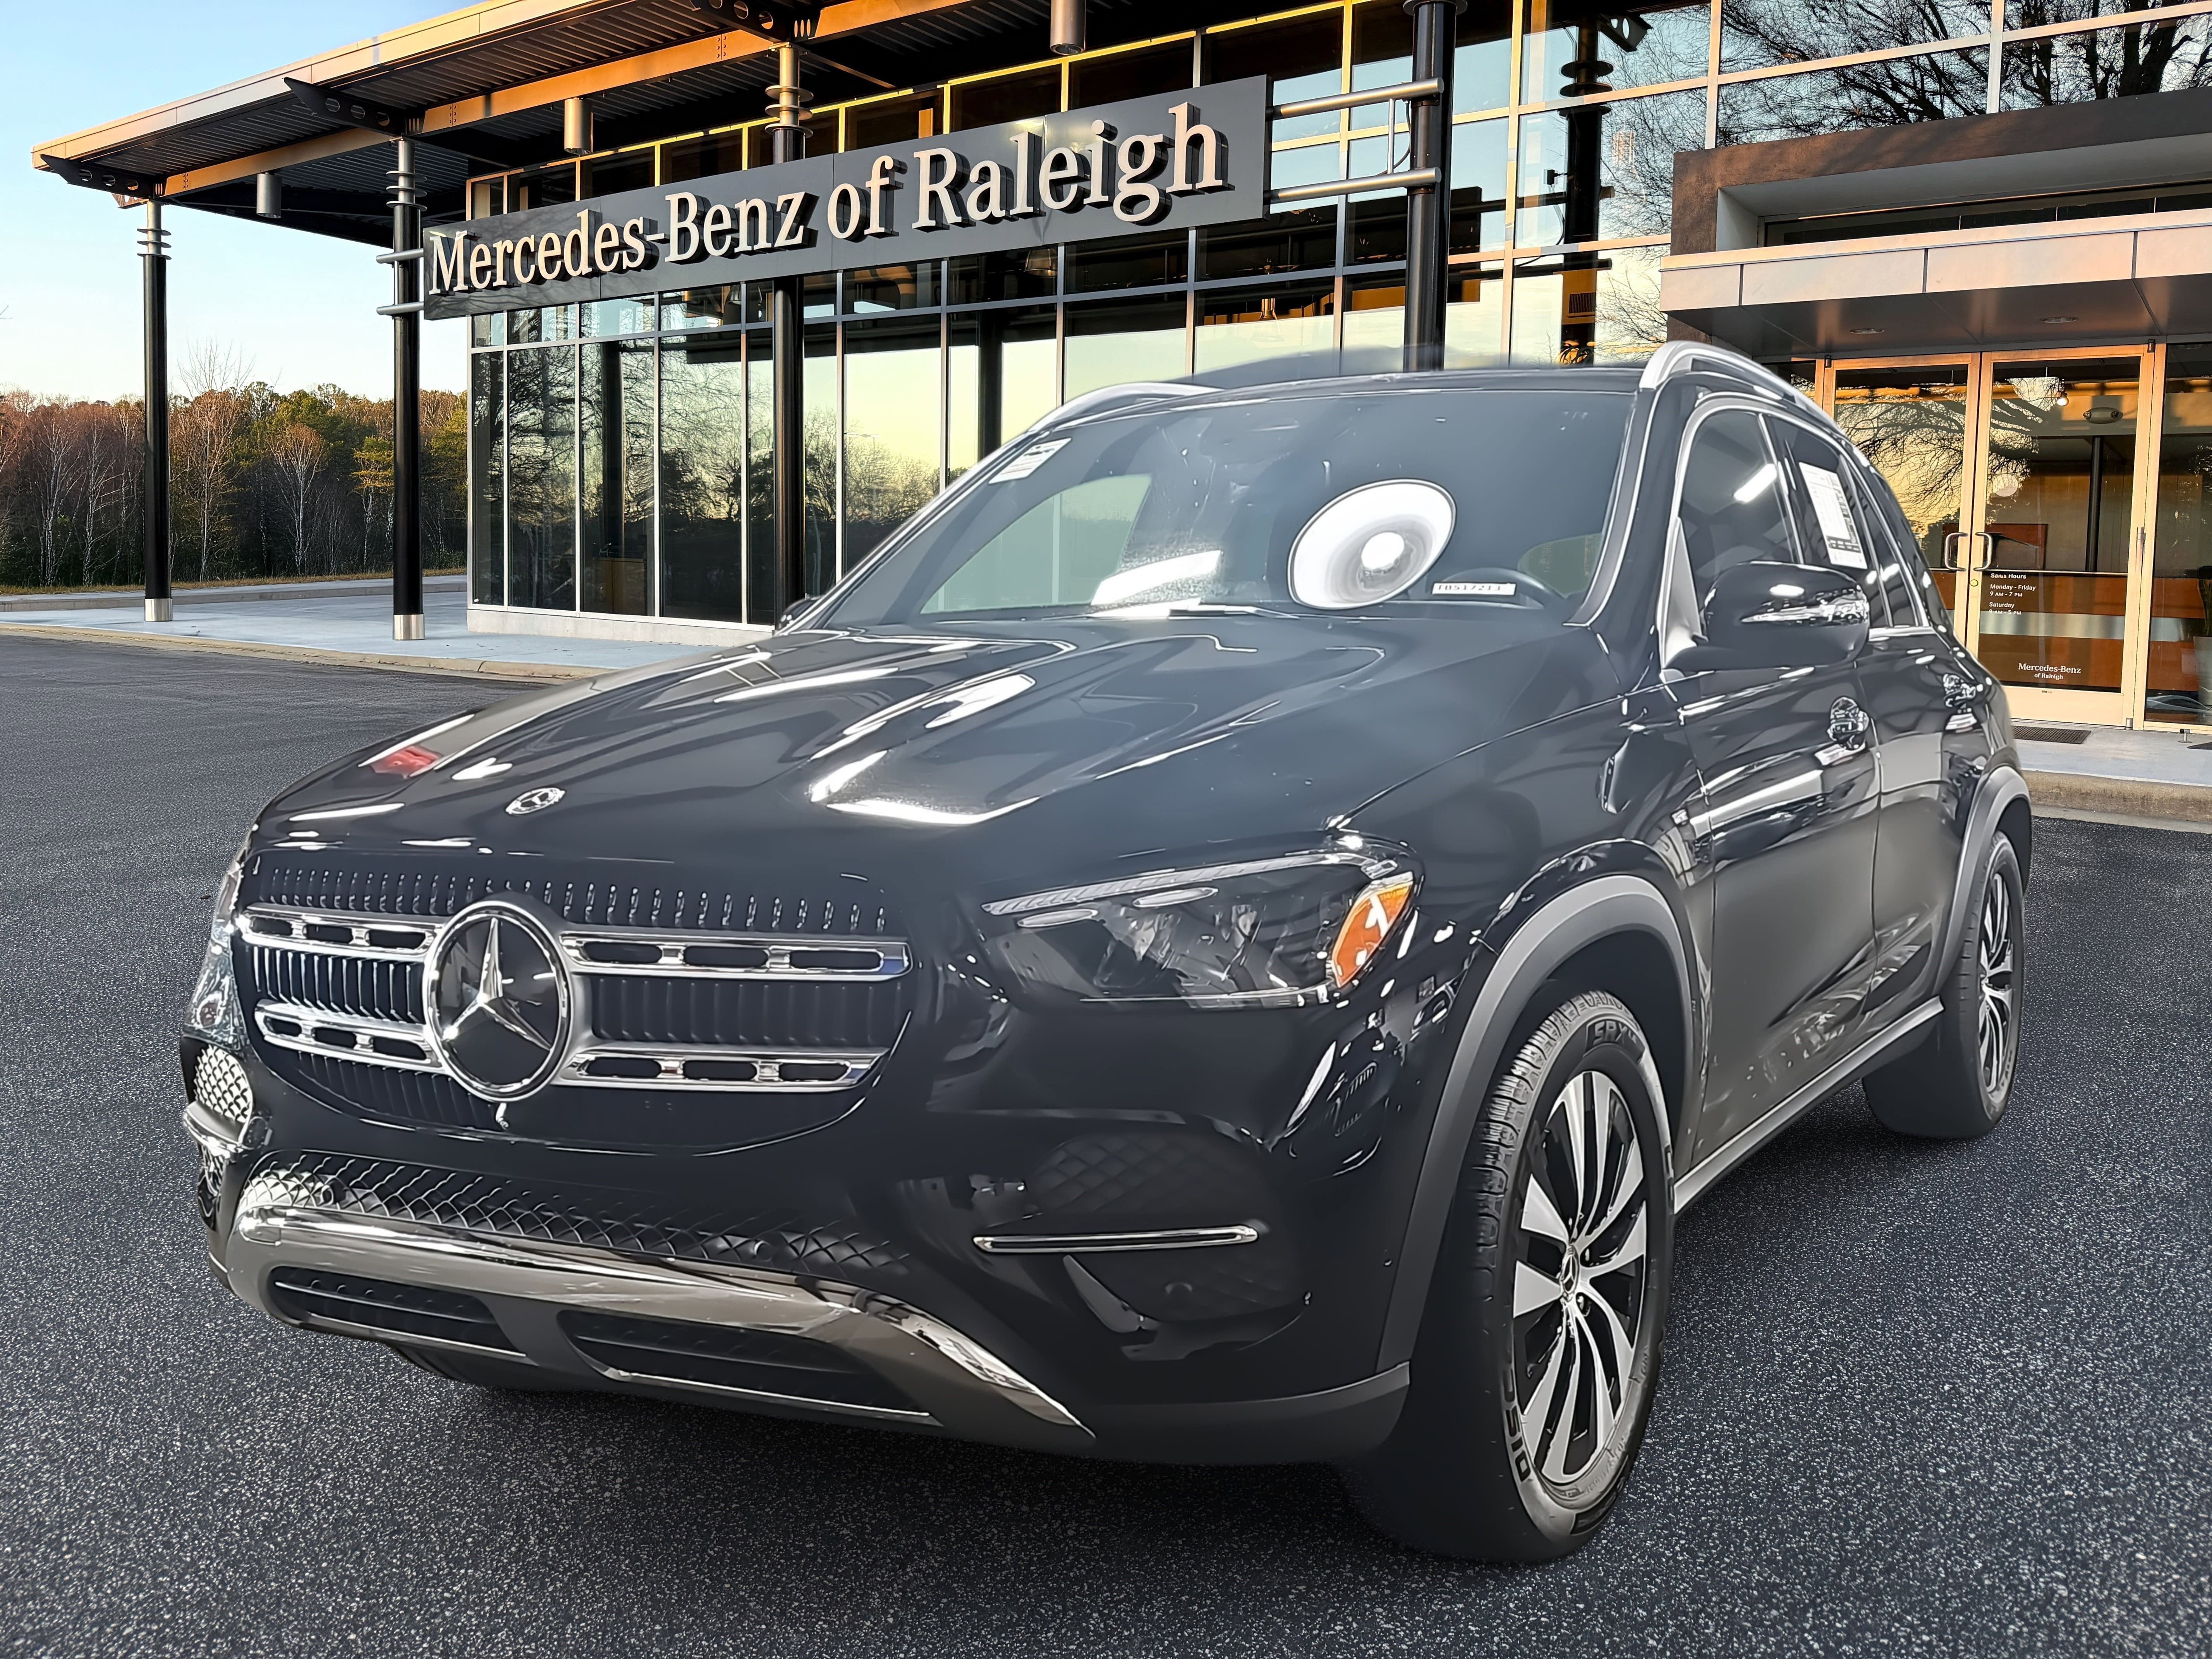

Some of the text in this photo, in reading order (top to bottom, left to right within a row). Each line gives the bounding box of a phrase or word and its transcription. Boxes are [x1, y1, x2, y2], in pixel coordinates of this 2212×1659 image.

[429, 101, 1223, 295] Mercedes-Benz of Raleigh
[2018, 663, 2081, 674] Mercedes-Benz
